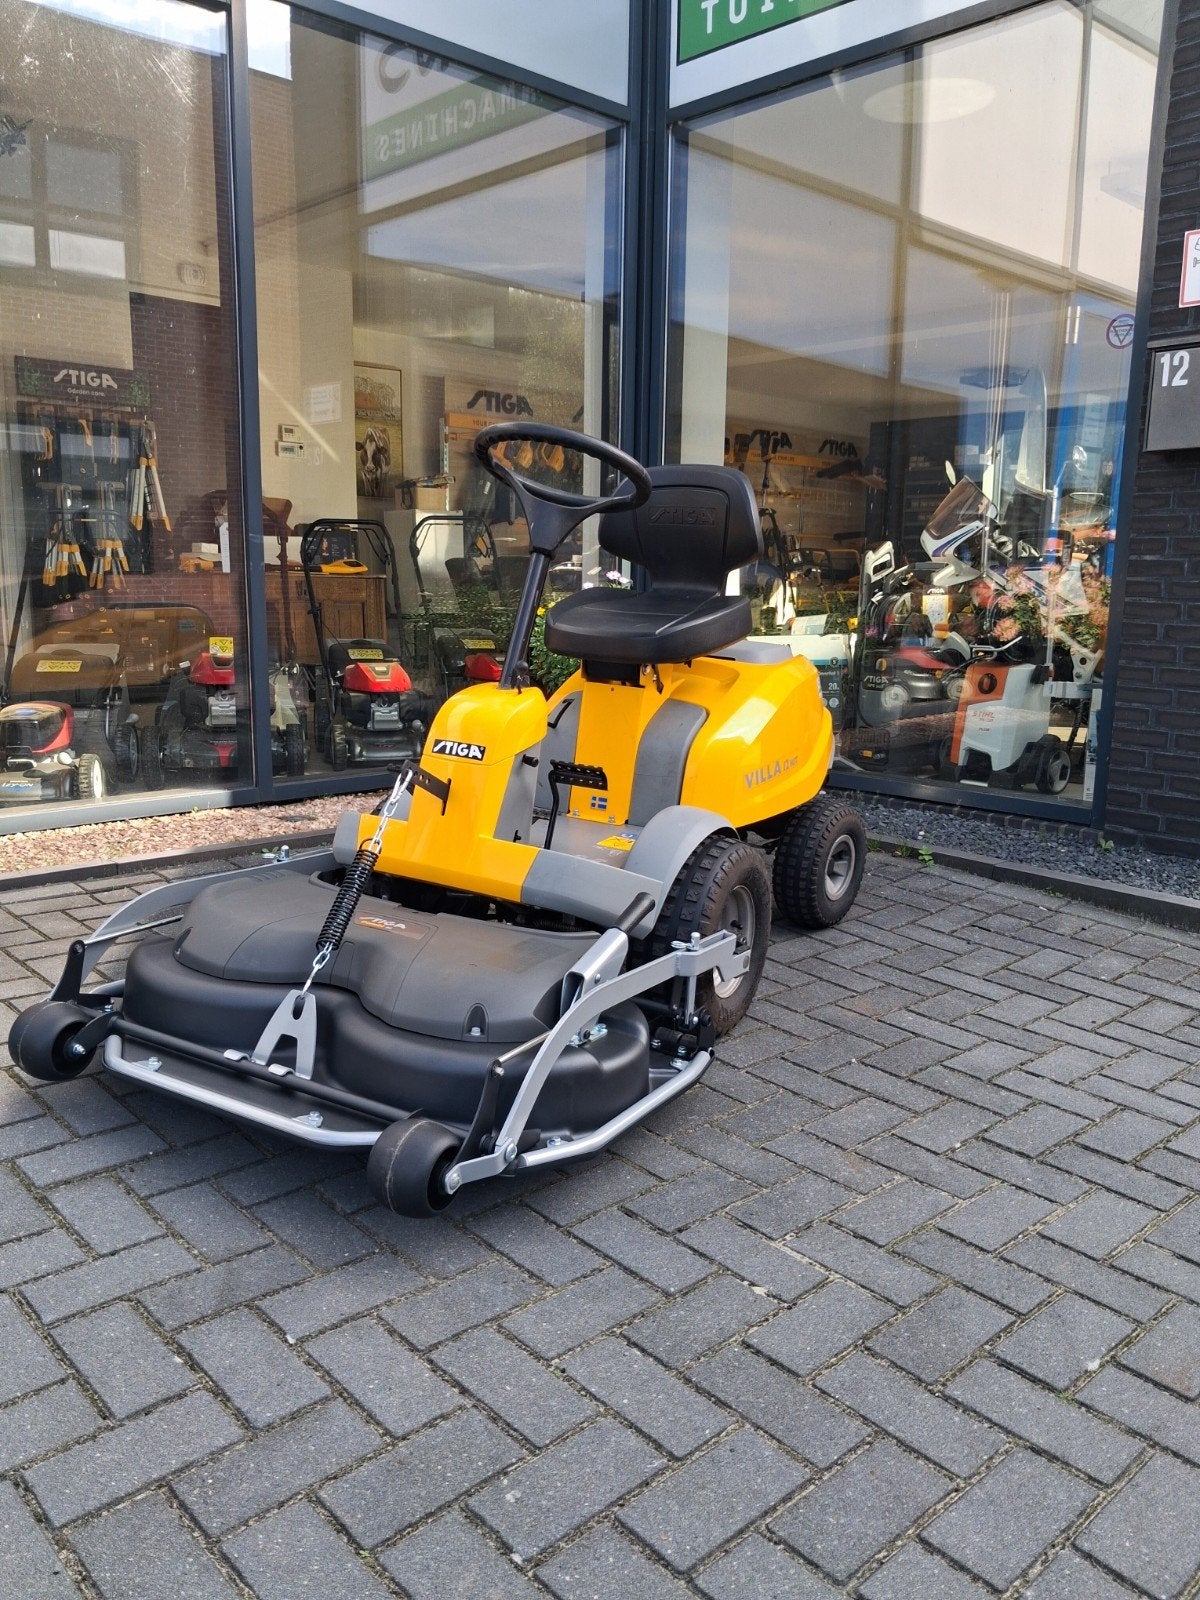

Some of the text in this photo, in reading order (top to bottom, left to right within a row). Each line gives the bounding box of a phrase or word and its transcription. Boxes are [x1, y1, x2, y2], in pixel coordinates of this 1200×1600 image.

[700, 0, 794, 34] TU
[53, 368, 118, 389] STIGA
[1160, 350, 1190, 387] 12
[467, 389, 534, 417] STIGA
[818, 438, 858, 458] STIGA
[648, 507, 716, 527] STIGA
[864, 675, 889, 684] STIGA
[433, 740, 483, 759] STIGA
[745, 760, 781, 789] VILLA
[358, 916, 406, 929] STIGA
